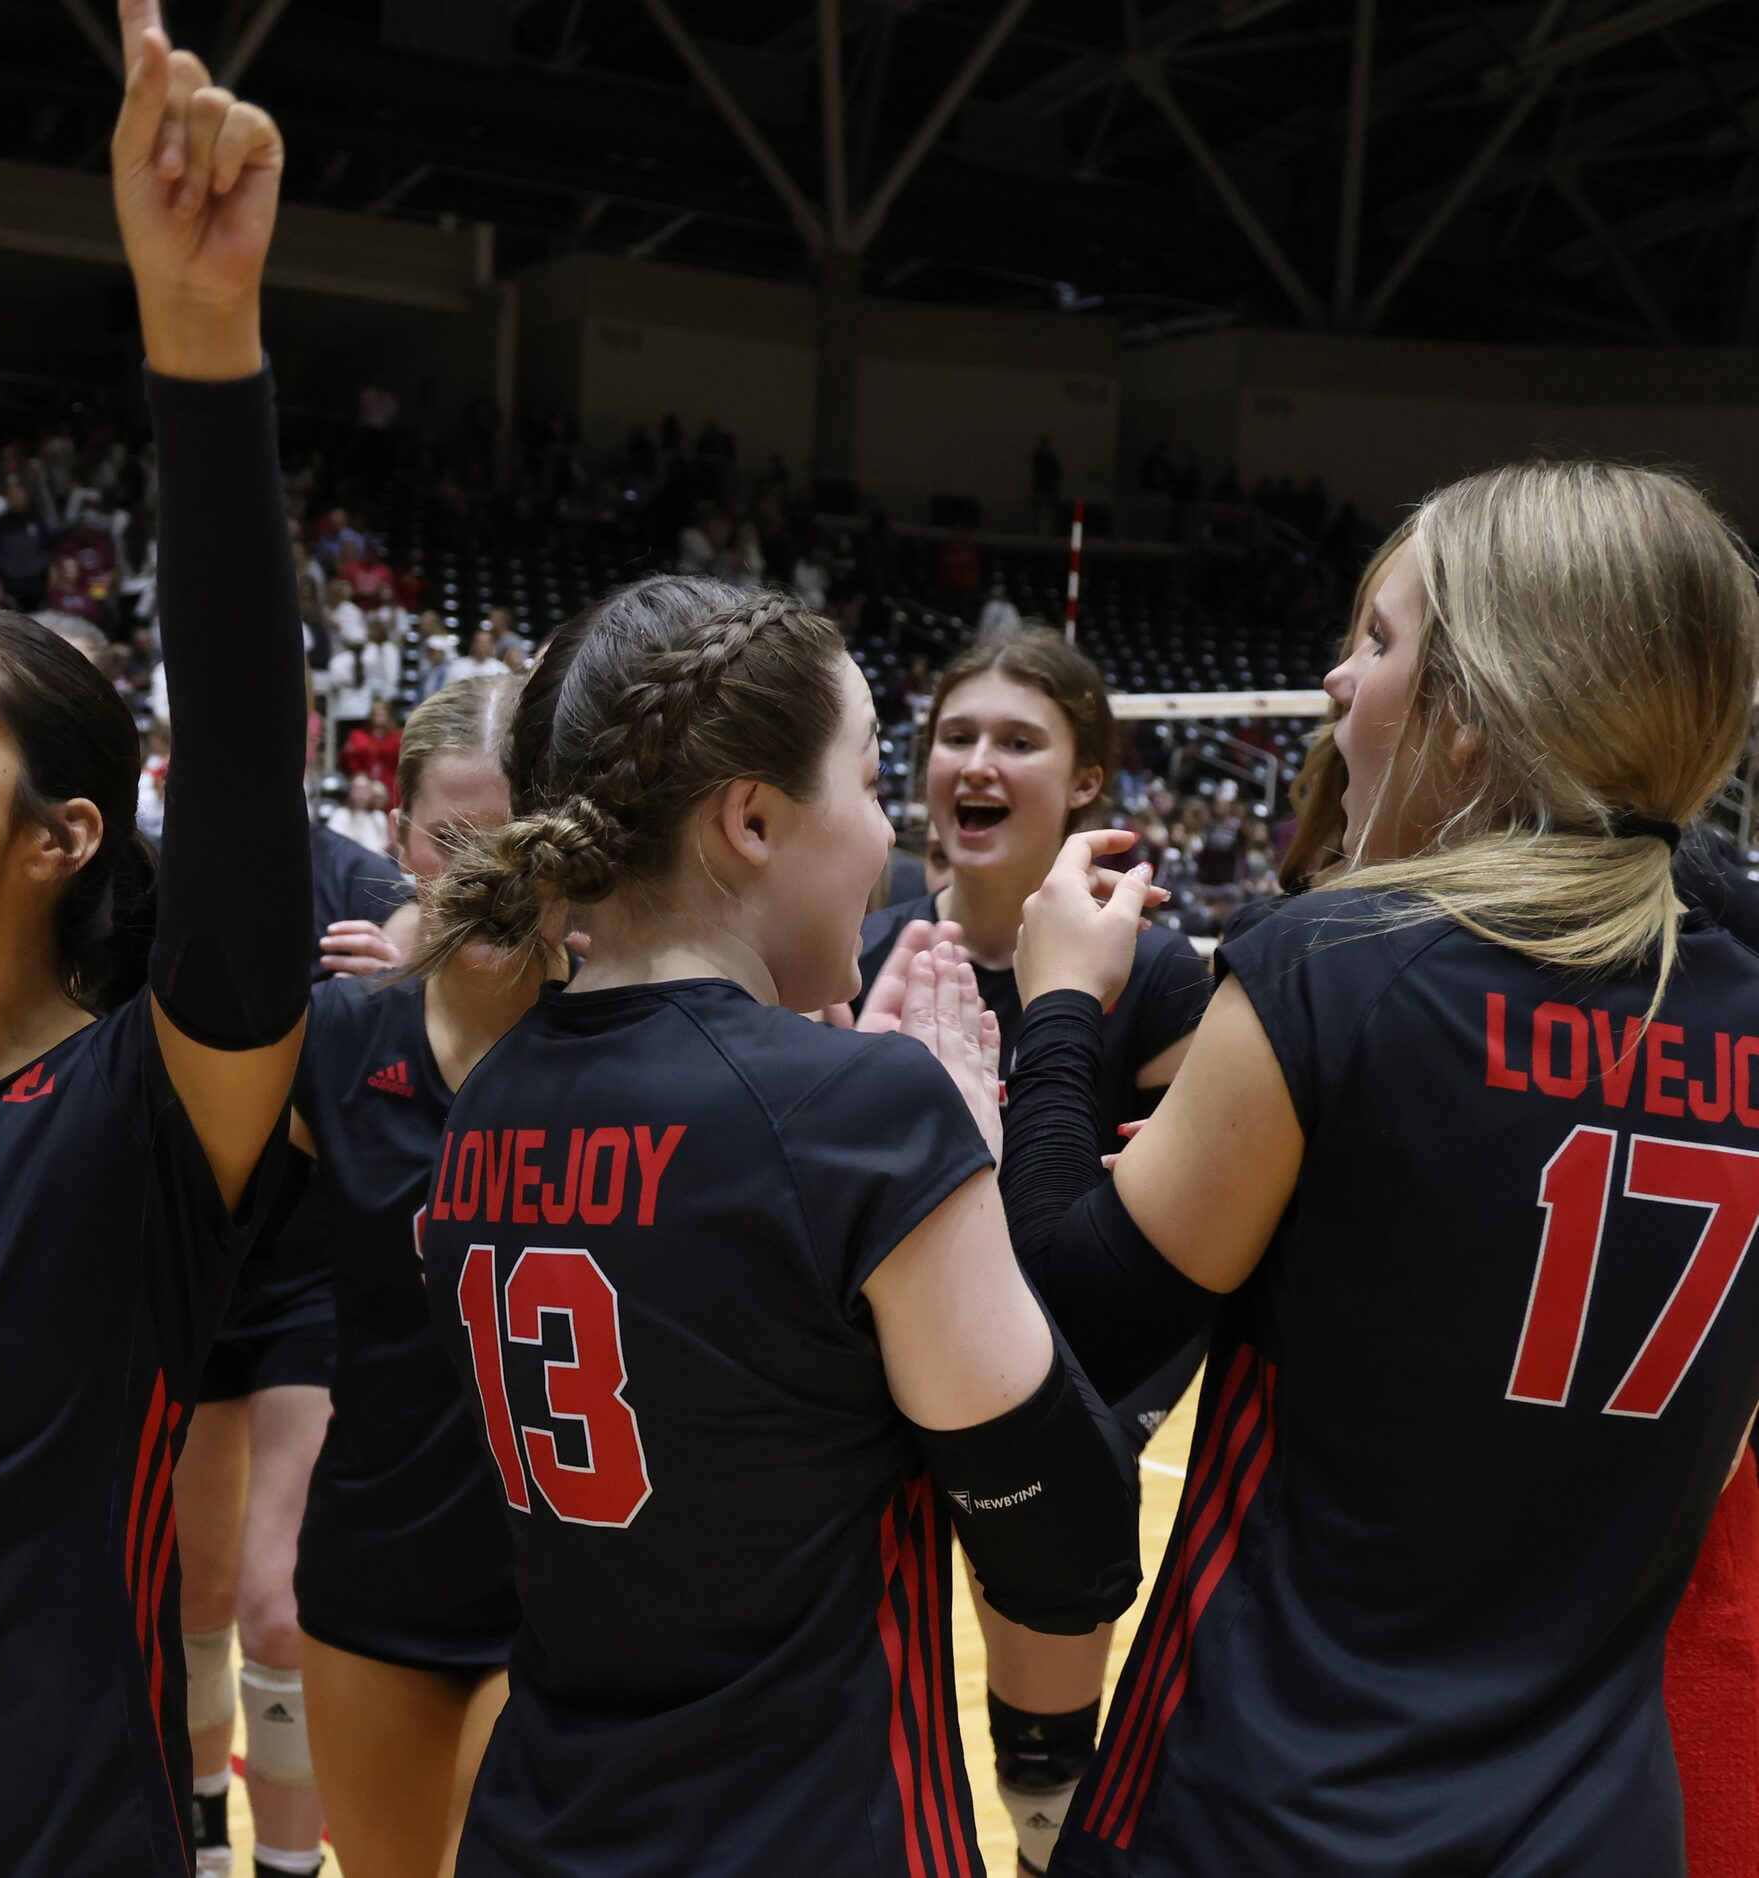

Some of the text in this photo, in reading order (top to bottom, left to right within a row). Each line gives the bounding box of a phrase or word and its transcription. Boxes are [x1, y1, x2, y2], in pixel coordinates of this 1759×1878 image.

[432, 1125, 688, 1226] LOVEJOY
[1504, 1123, 1759, 1420] 17
[457, 1243, 654, 1529] 13
[974, 1480, 1043, 1510] NEWBYINN
